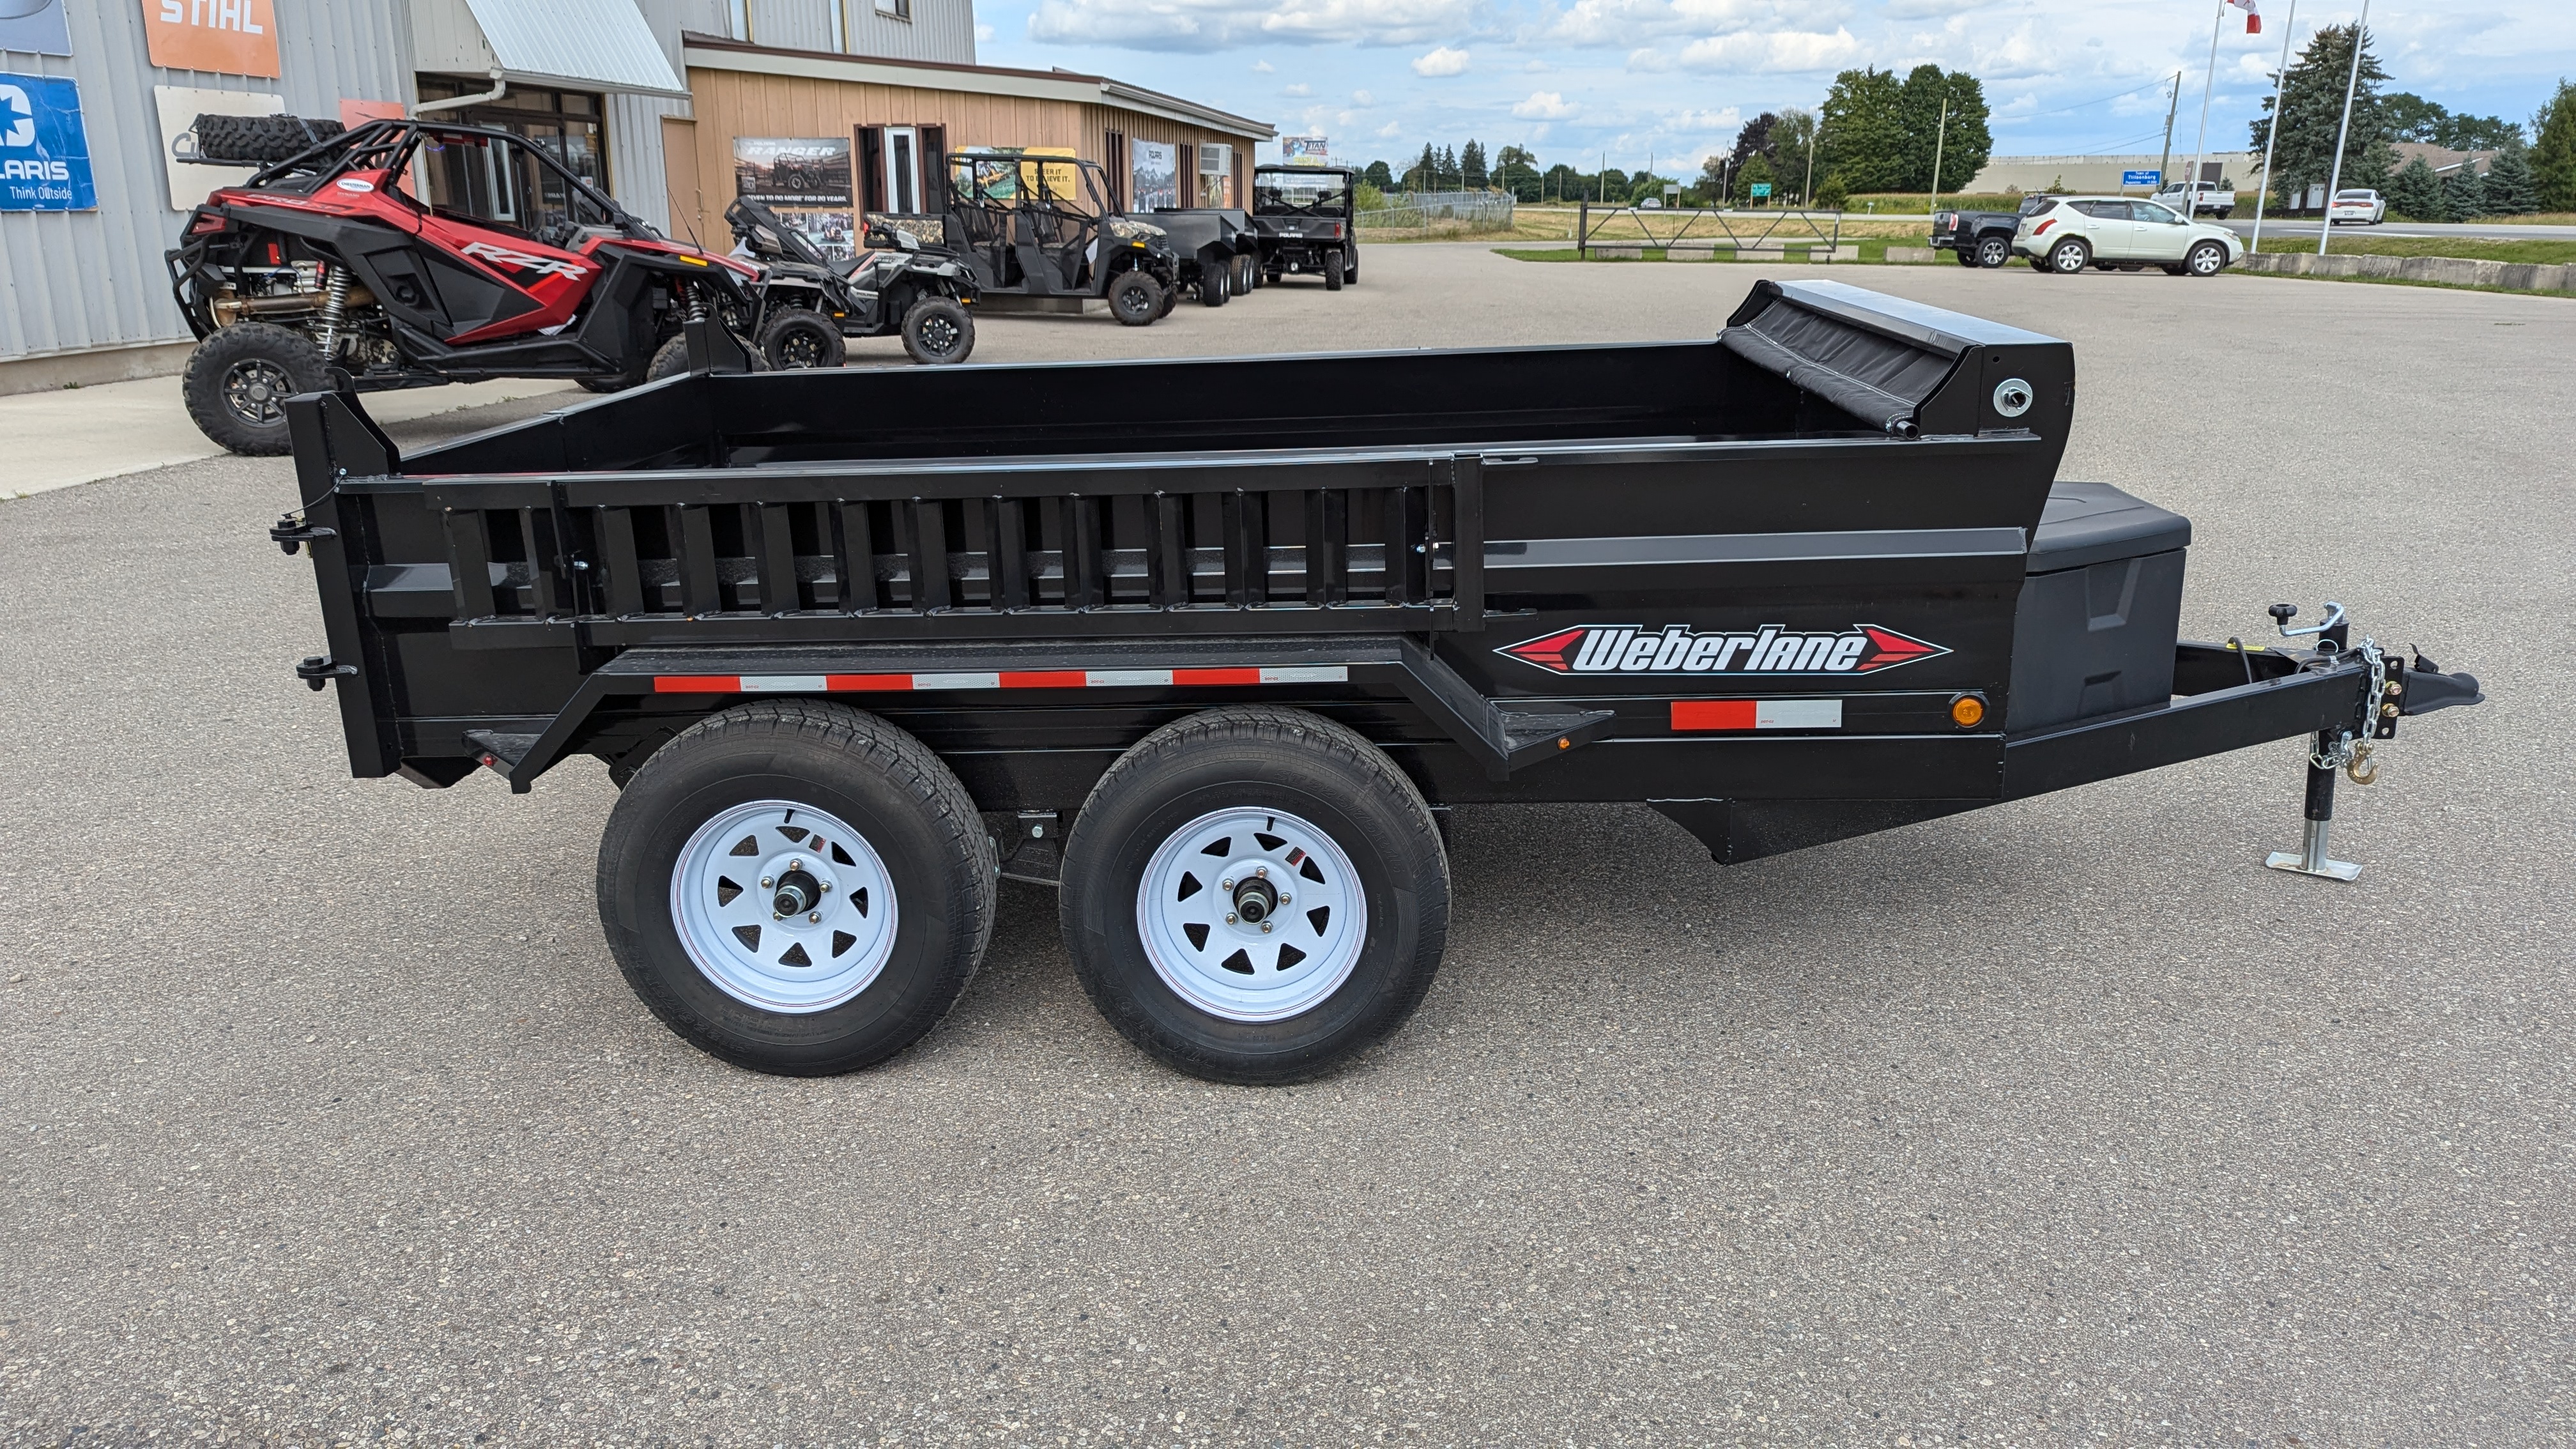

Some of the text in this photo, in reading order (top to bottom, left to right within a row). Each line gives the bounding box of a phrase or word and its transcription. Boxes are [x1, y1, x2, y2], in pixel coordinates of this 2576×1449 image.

[160, 0, 263, 34] STIHL
[746, 146, 836, 156] RANGER
[9, 186, 72, 200] Think Outside
[461, 241, 588, 281] RZR
[1572, 629, 1868, 671] Weberlane
[1273, 769, 1307, 785] ST
[1305, 778, 1406, 873] 225/75R15
